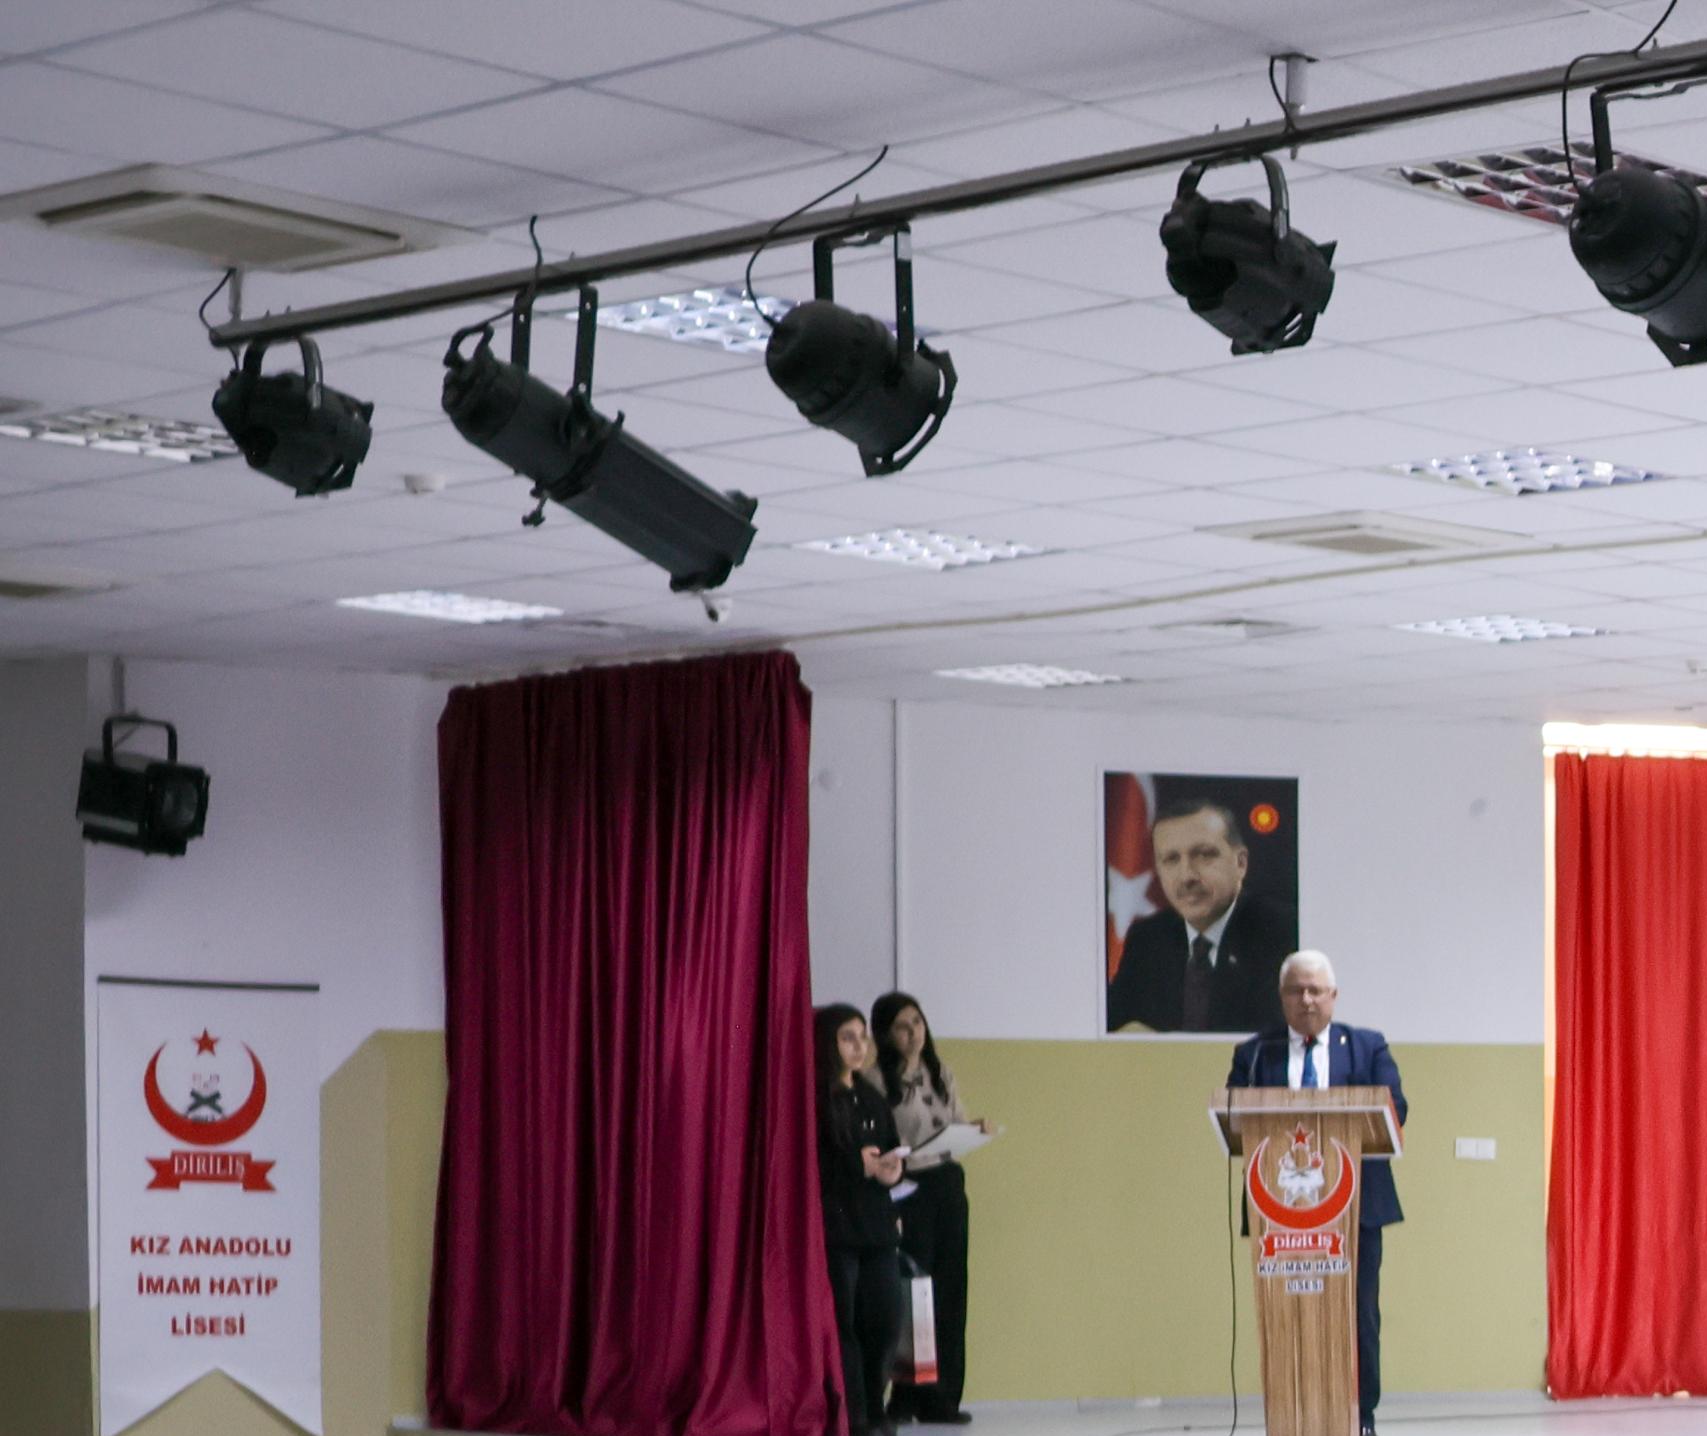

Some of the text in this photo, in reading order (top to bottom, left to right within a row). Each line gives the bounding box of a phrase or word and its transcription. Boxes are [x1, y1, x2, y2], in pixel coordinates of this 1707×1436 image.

[173, 1153, 246, 1178] DİRİLİŞ
[130, 1236, 292, 1257] KIZ ANADOLU
[138, 1272, 278, 1297] İMAM HATİP
[171, 1312, 245, 1337] LİSESİ
